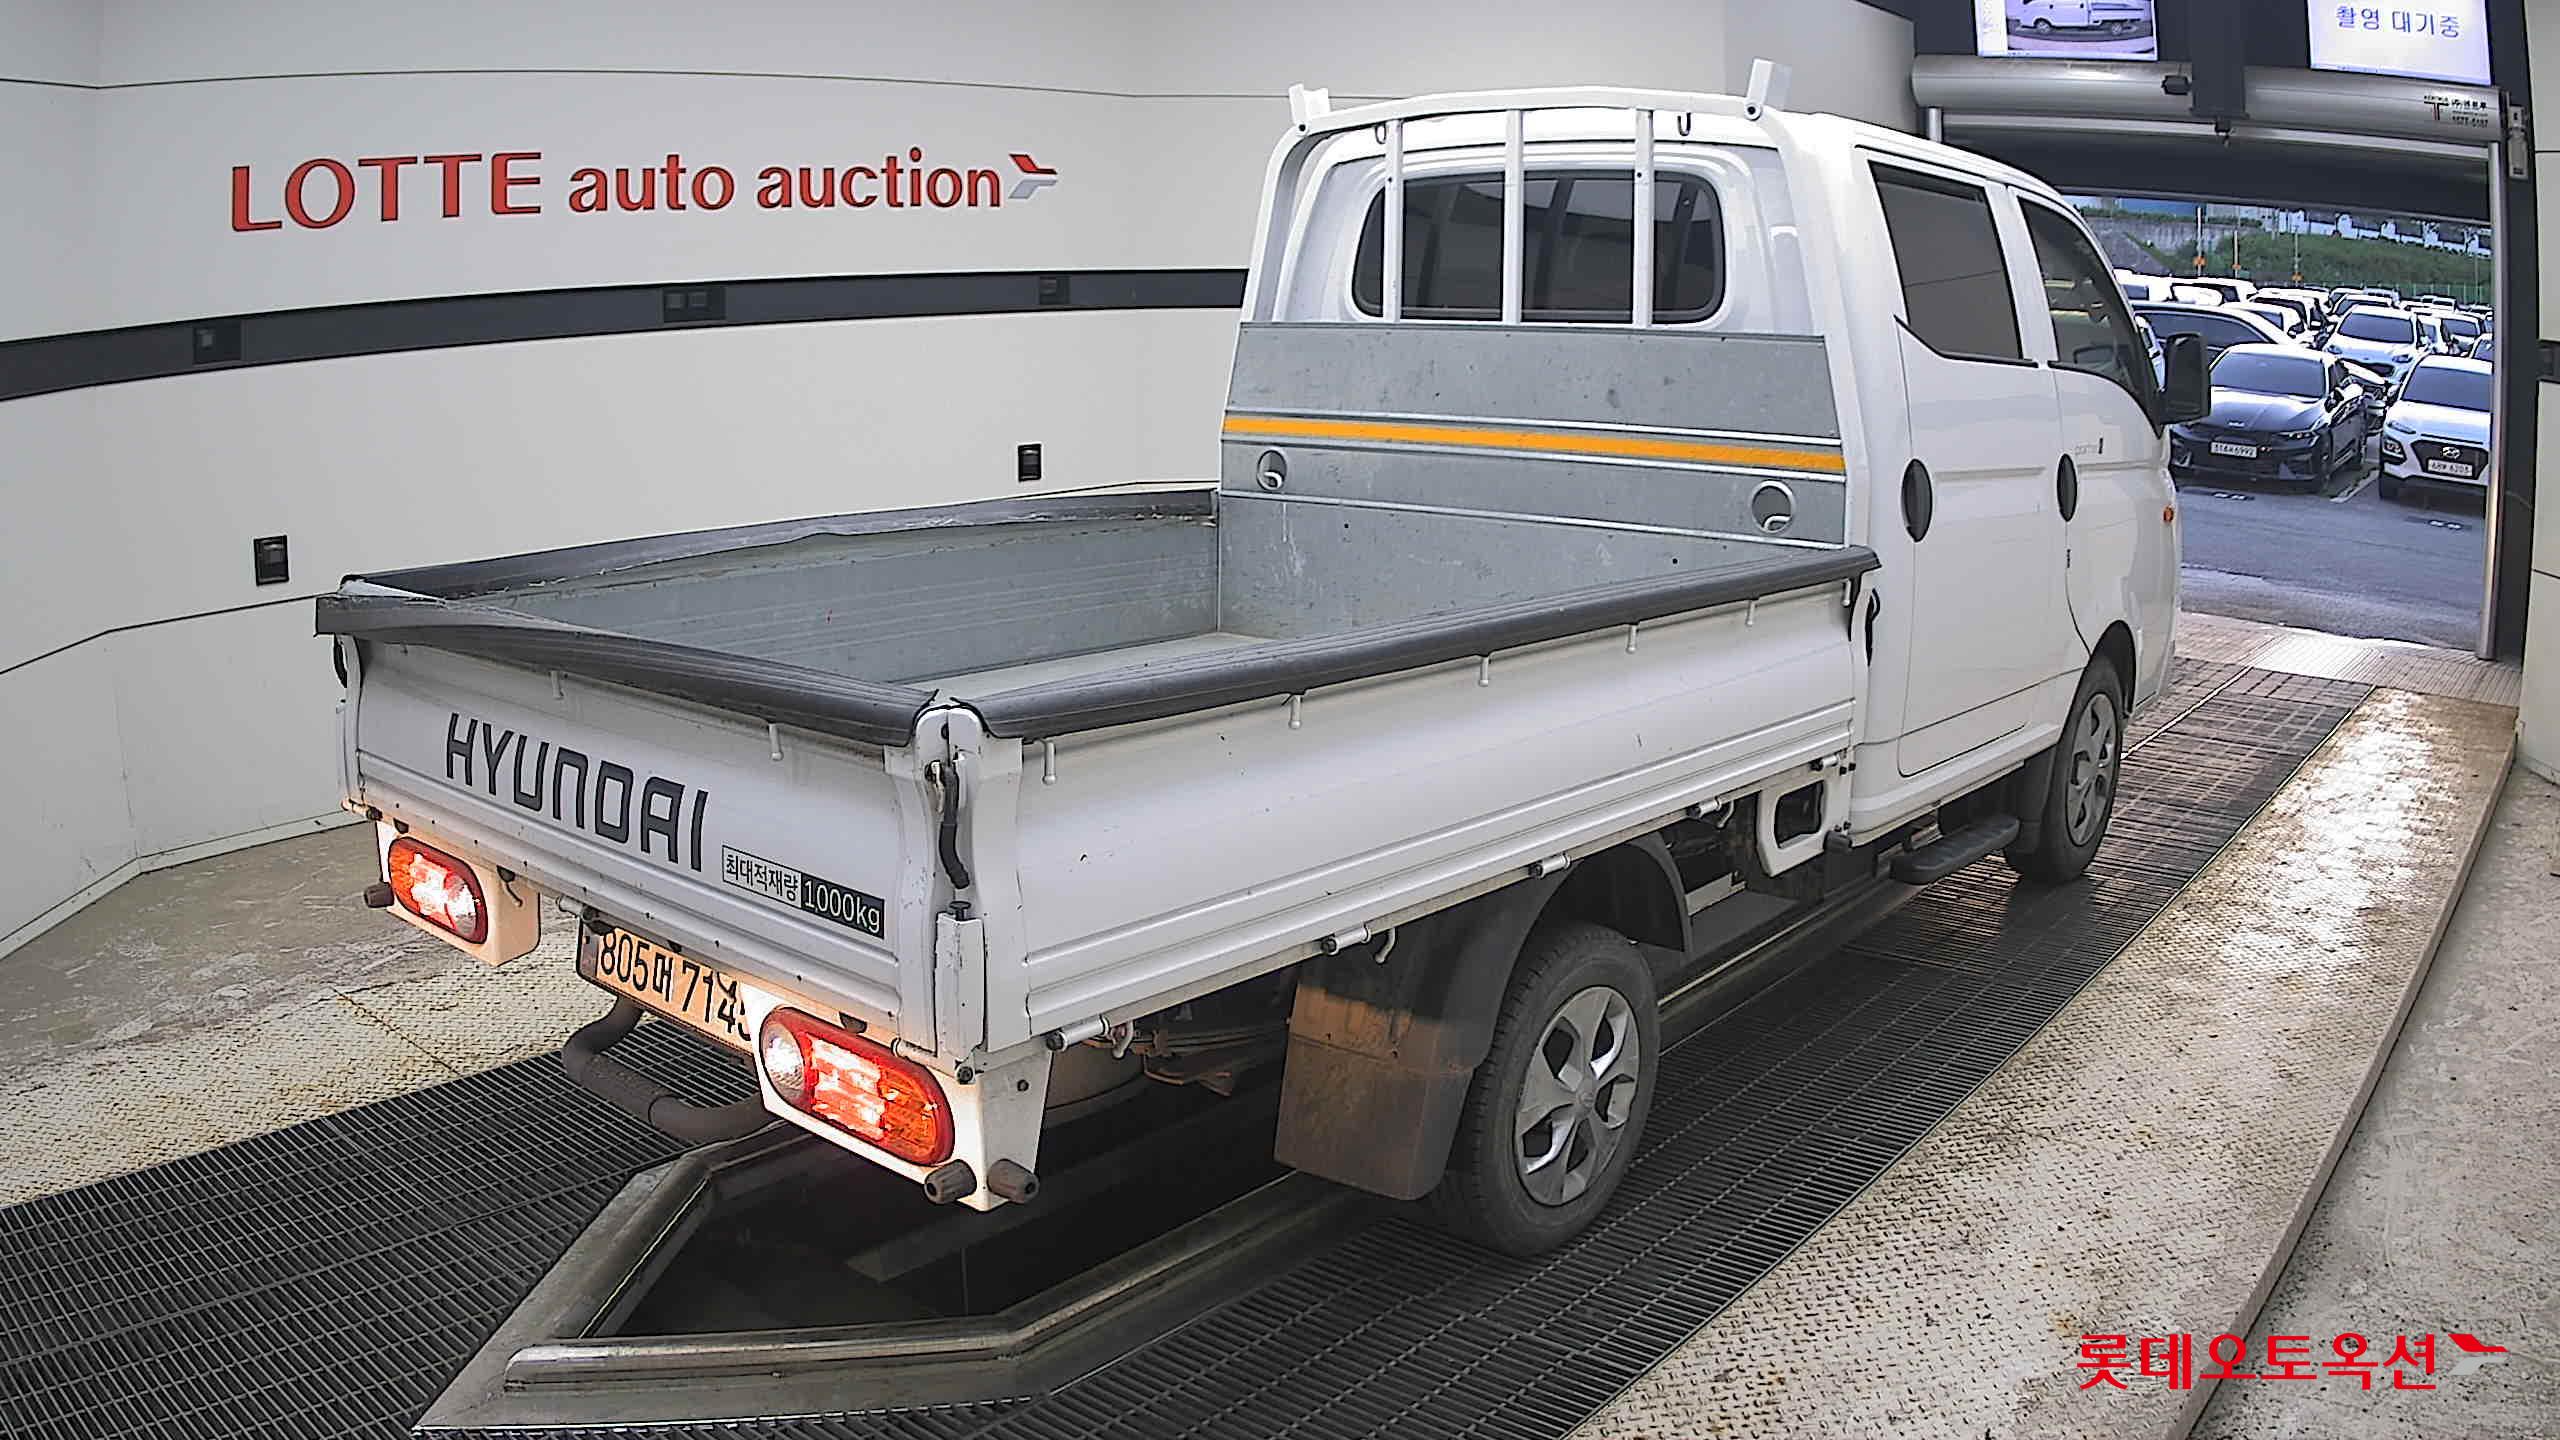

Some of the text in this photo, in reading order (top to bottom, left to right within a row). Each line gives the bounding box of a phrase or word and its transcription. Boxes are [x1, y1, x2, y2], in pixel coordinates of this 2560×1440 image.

[2337, 5, 2460, 39] 촬영 대기중
[231, 147, 1002, 232] LOTTE auto auction
[446, 712, 709, 872] HYUNDAI
[726, 854, 881, 934] 최대적재량 1000kg
